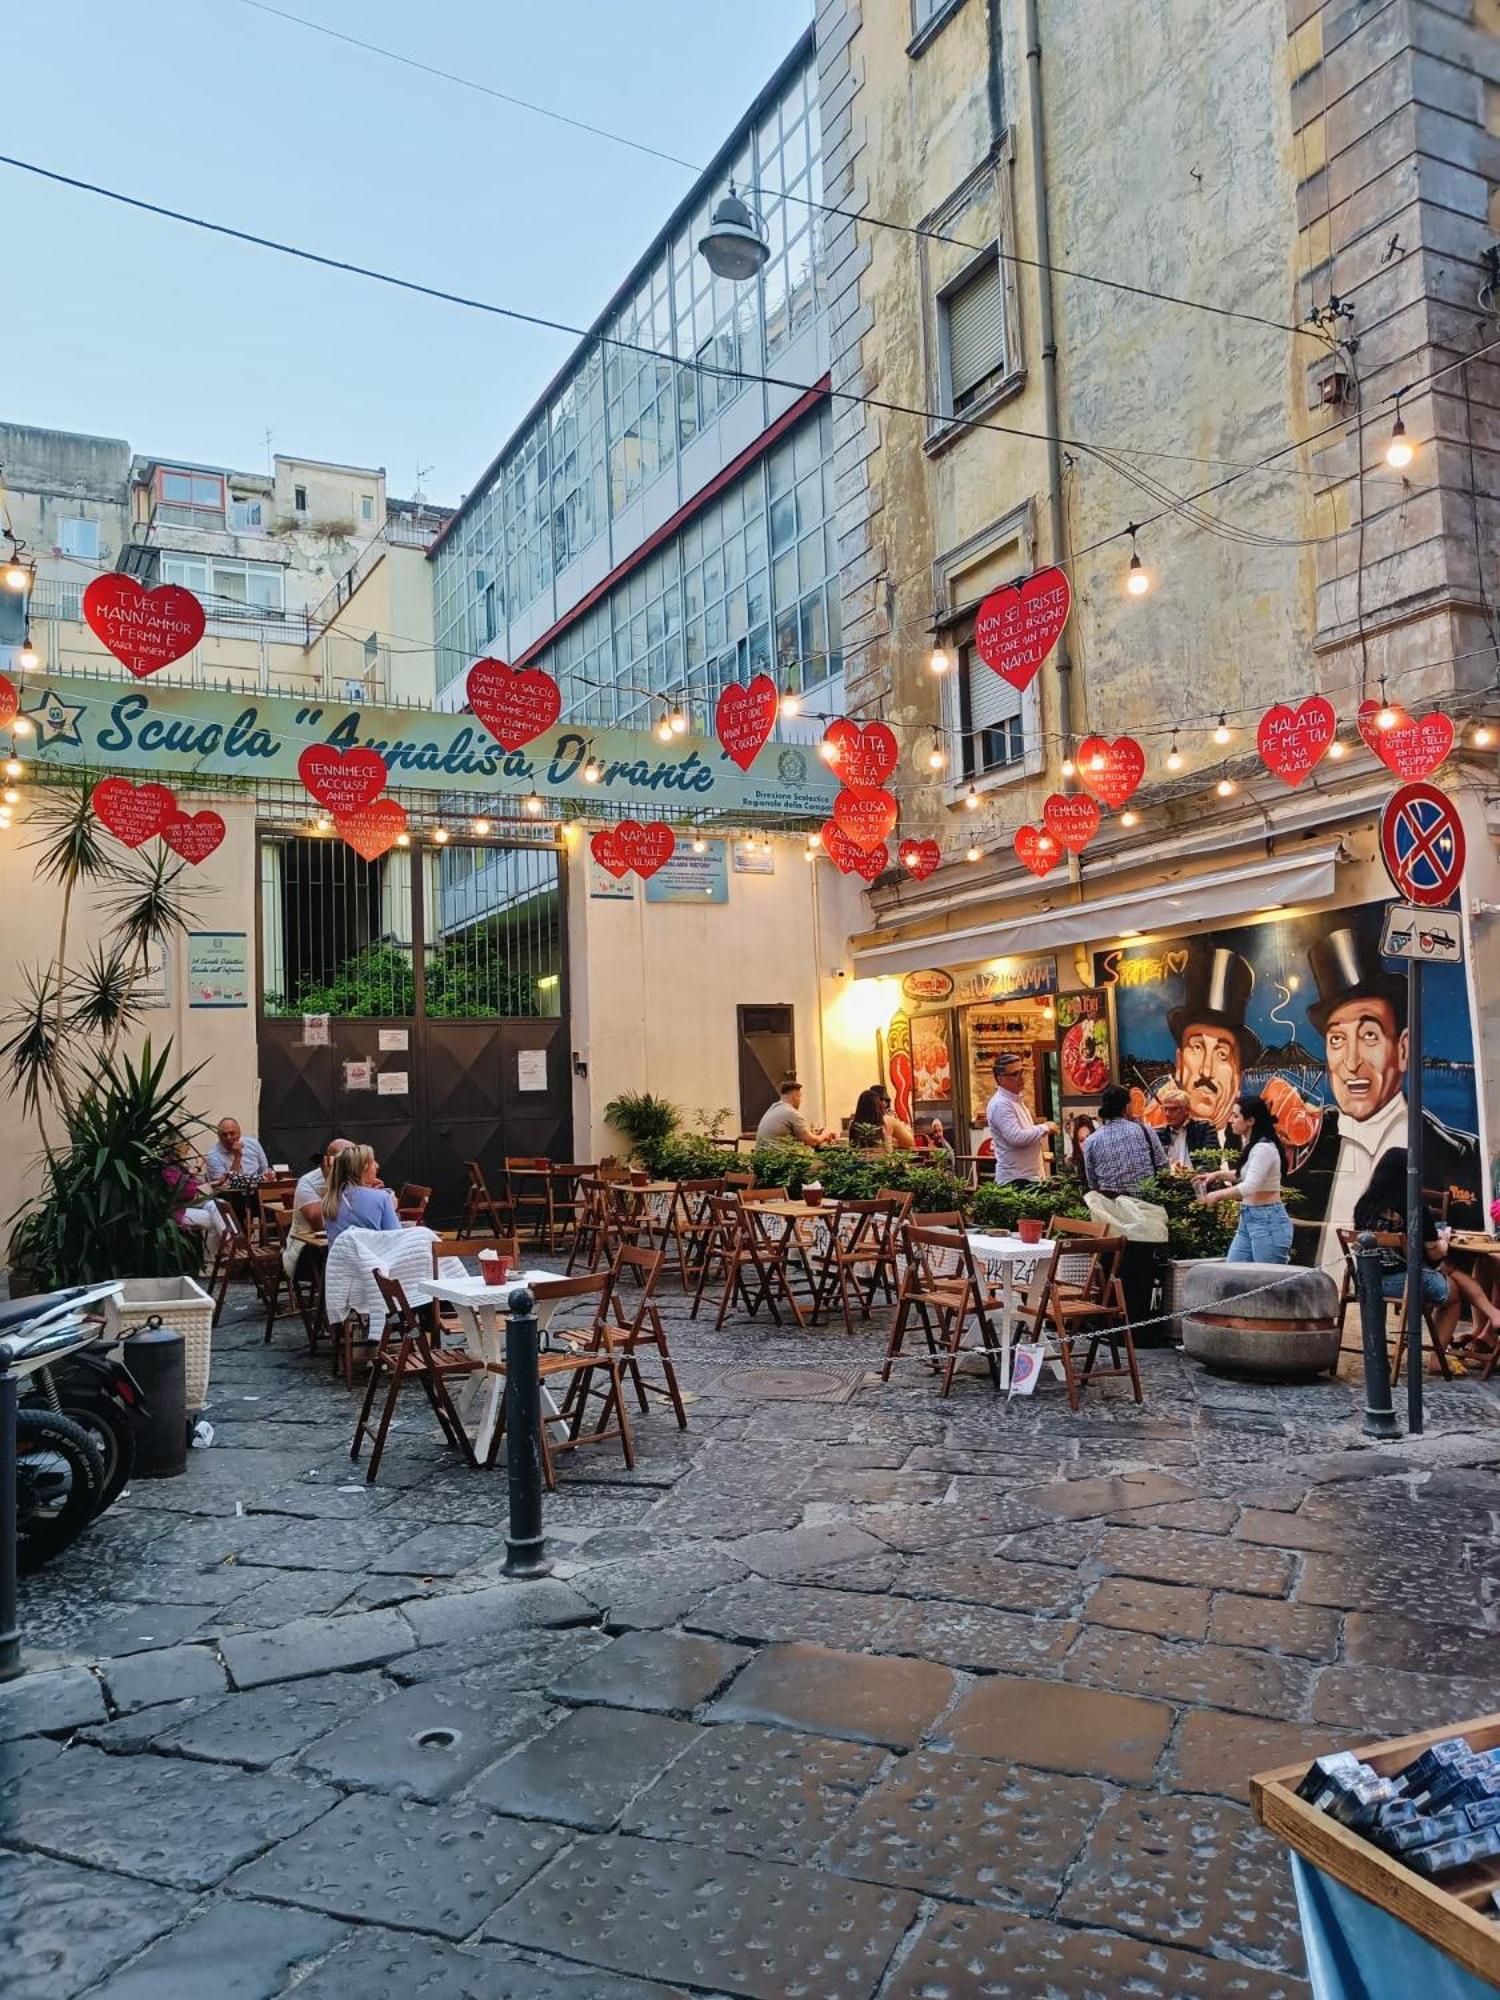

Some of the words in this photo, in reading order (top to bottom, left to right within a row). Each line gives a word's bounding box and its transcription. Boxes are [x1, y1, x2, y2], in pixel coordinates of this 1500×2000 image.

[133, 594, 158, 612] VEC
[164, 601, 177, 616] E
[978, 613, 1000, 634] NON
[1005, 605, 1020, 622] SEI
[1024, 586, 1065, 613] TRISTE
[981, 632, 998, 647] HAI
[1001, 622, 1023, 637] SOLO
[1026, 606, 1065, 629] BISOGNO
[107, 624, 115, 635] S
[119, 623, 161, 644] FERMN
[166, 634, 177, 648] E
[996, 637, 1020, 656] STARE
[132, 656, 147, 671] TE
[1001, 641, 1042, 673] NAPOLI
[474, 672, 505, 687] TANTO
[472, 684, 501, 698] VAJE
[504, 691, 541, 707] PAZZE
[497, 704, 525, 717] DIMME
[97, 694, 282, 757] Scuola
[1269, 710, 1326, 735] MALATIA
[838, 734, 848, 750] A
[850, 734, 886, 753] VITA
[1262, 737, 1279, 753] PE
[1282, 732, 1303, 748] ME
[877, 753, 889, 766] TE
[1292, 747, 1308, 758] NA
[863, 766, 878, 777] FA
[1276, 759, 1313, 773] MALATIA
[742, 797, 782, 808] Regionale
[784, 801, 802, 809] della
[755, 790, 792, 800] Direzione
[333, 802, 355, 811] CORE
[859, 801, 887, 813] COSA
[1048, 803, 1096, 817] FEMMENA
[830, 841, 867, 858] ETERNA
